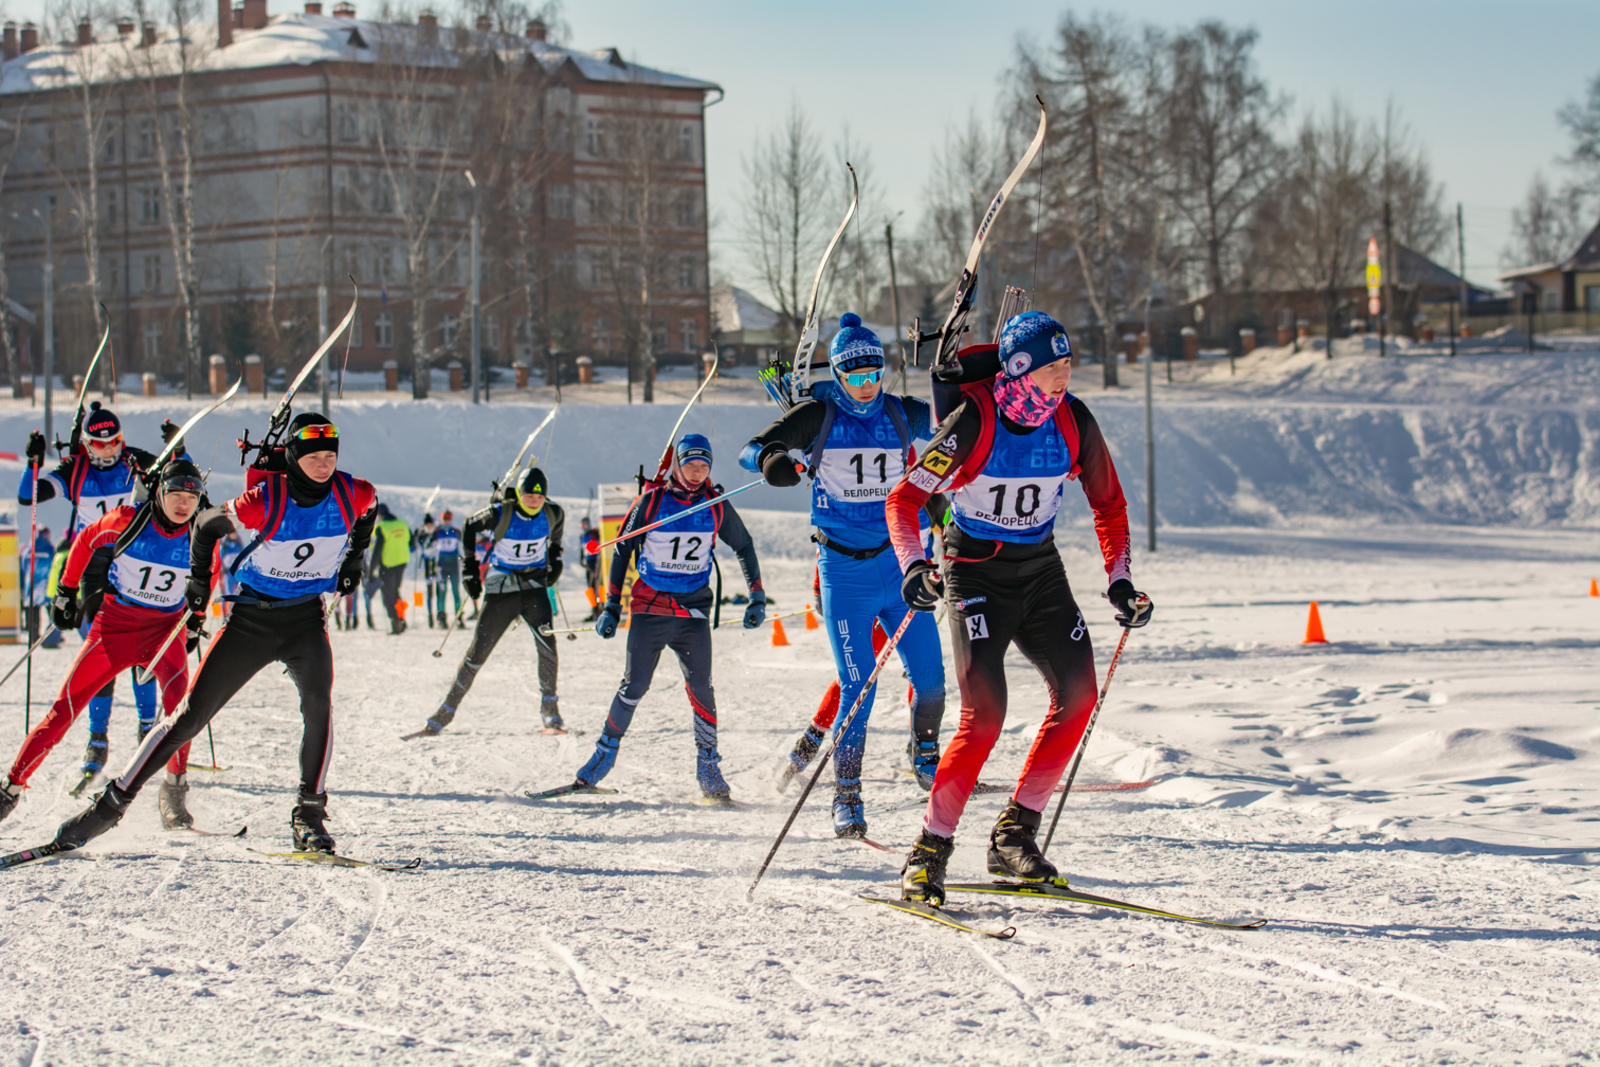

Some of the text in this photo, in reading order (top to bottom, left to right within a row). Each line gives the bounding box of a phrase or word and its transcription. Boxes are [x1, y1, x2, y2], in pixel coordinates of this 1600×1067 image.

[981, 193, 1004, 234] HOYT
[840, 347, 877, 361] RUSSIA
[88, 420, 115, 432] LUKOIL
[850, 453, 887, 484] 11
[816, 494, 829, 509] 11
[843, 487, 892, 498] БЕЛОРЕЦК
[989, 484, 1041, 518] 10
[96, 498, 125, 515] 1
[293, 542, 315, 568] 9
[512, 542, 538, 558] 15
[669, 536, 702, 561] 12
[139, 566, 176, 592] 13
[838, 619, 860, 682] SPINE
